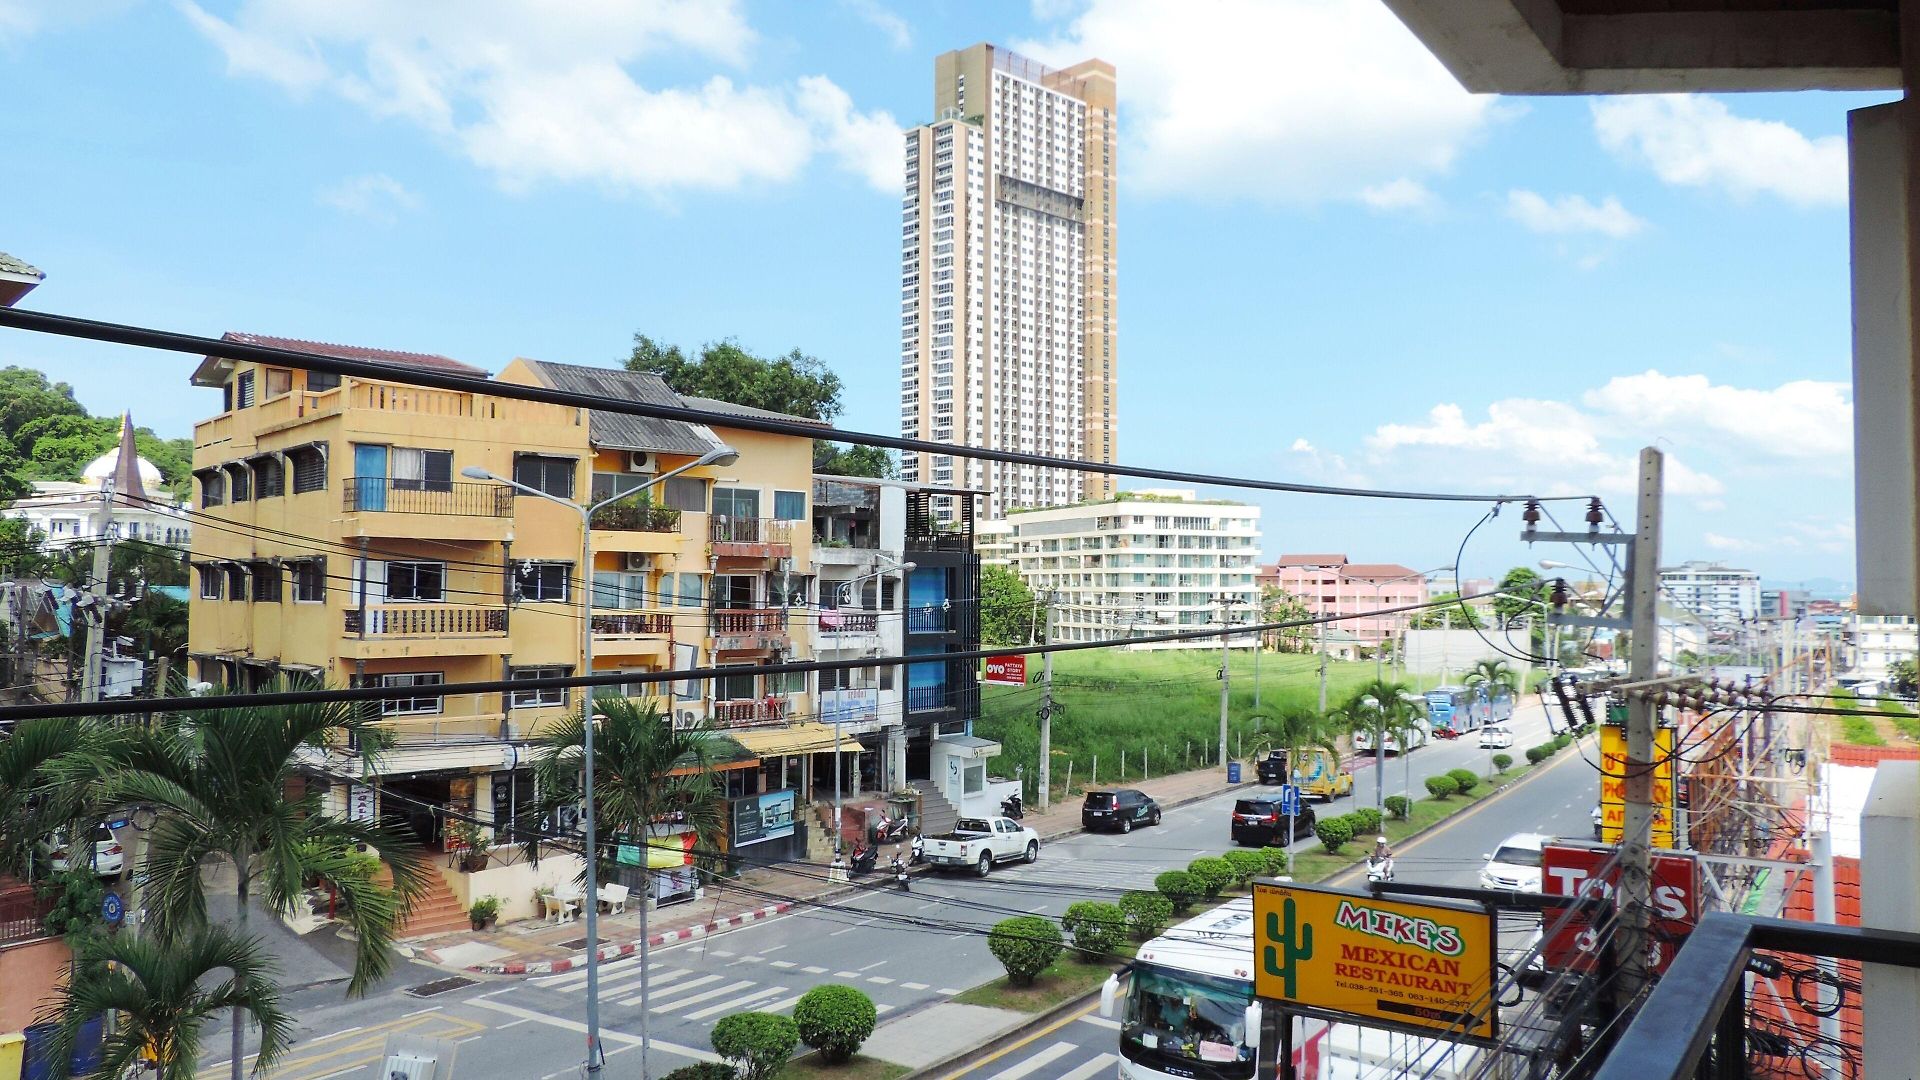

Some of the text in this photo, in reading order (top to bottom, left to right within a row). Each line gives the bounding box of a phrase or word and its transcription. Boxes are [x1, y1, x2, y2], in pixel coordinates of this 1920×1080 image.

[987, 664, 1004, 674] OYO
[1340, 943, 1462, 978] MEXICAN
[1334, 962, 1473, 997] RESTAURANT
